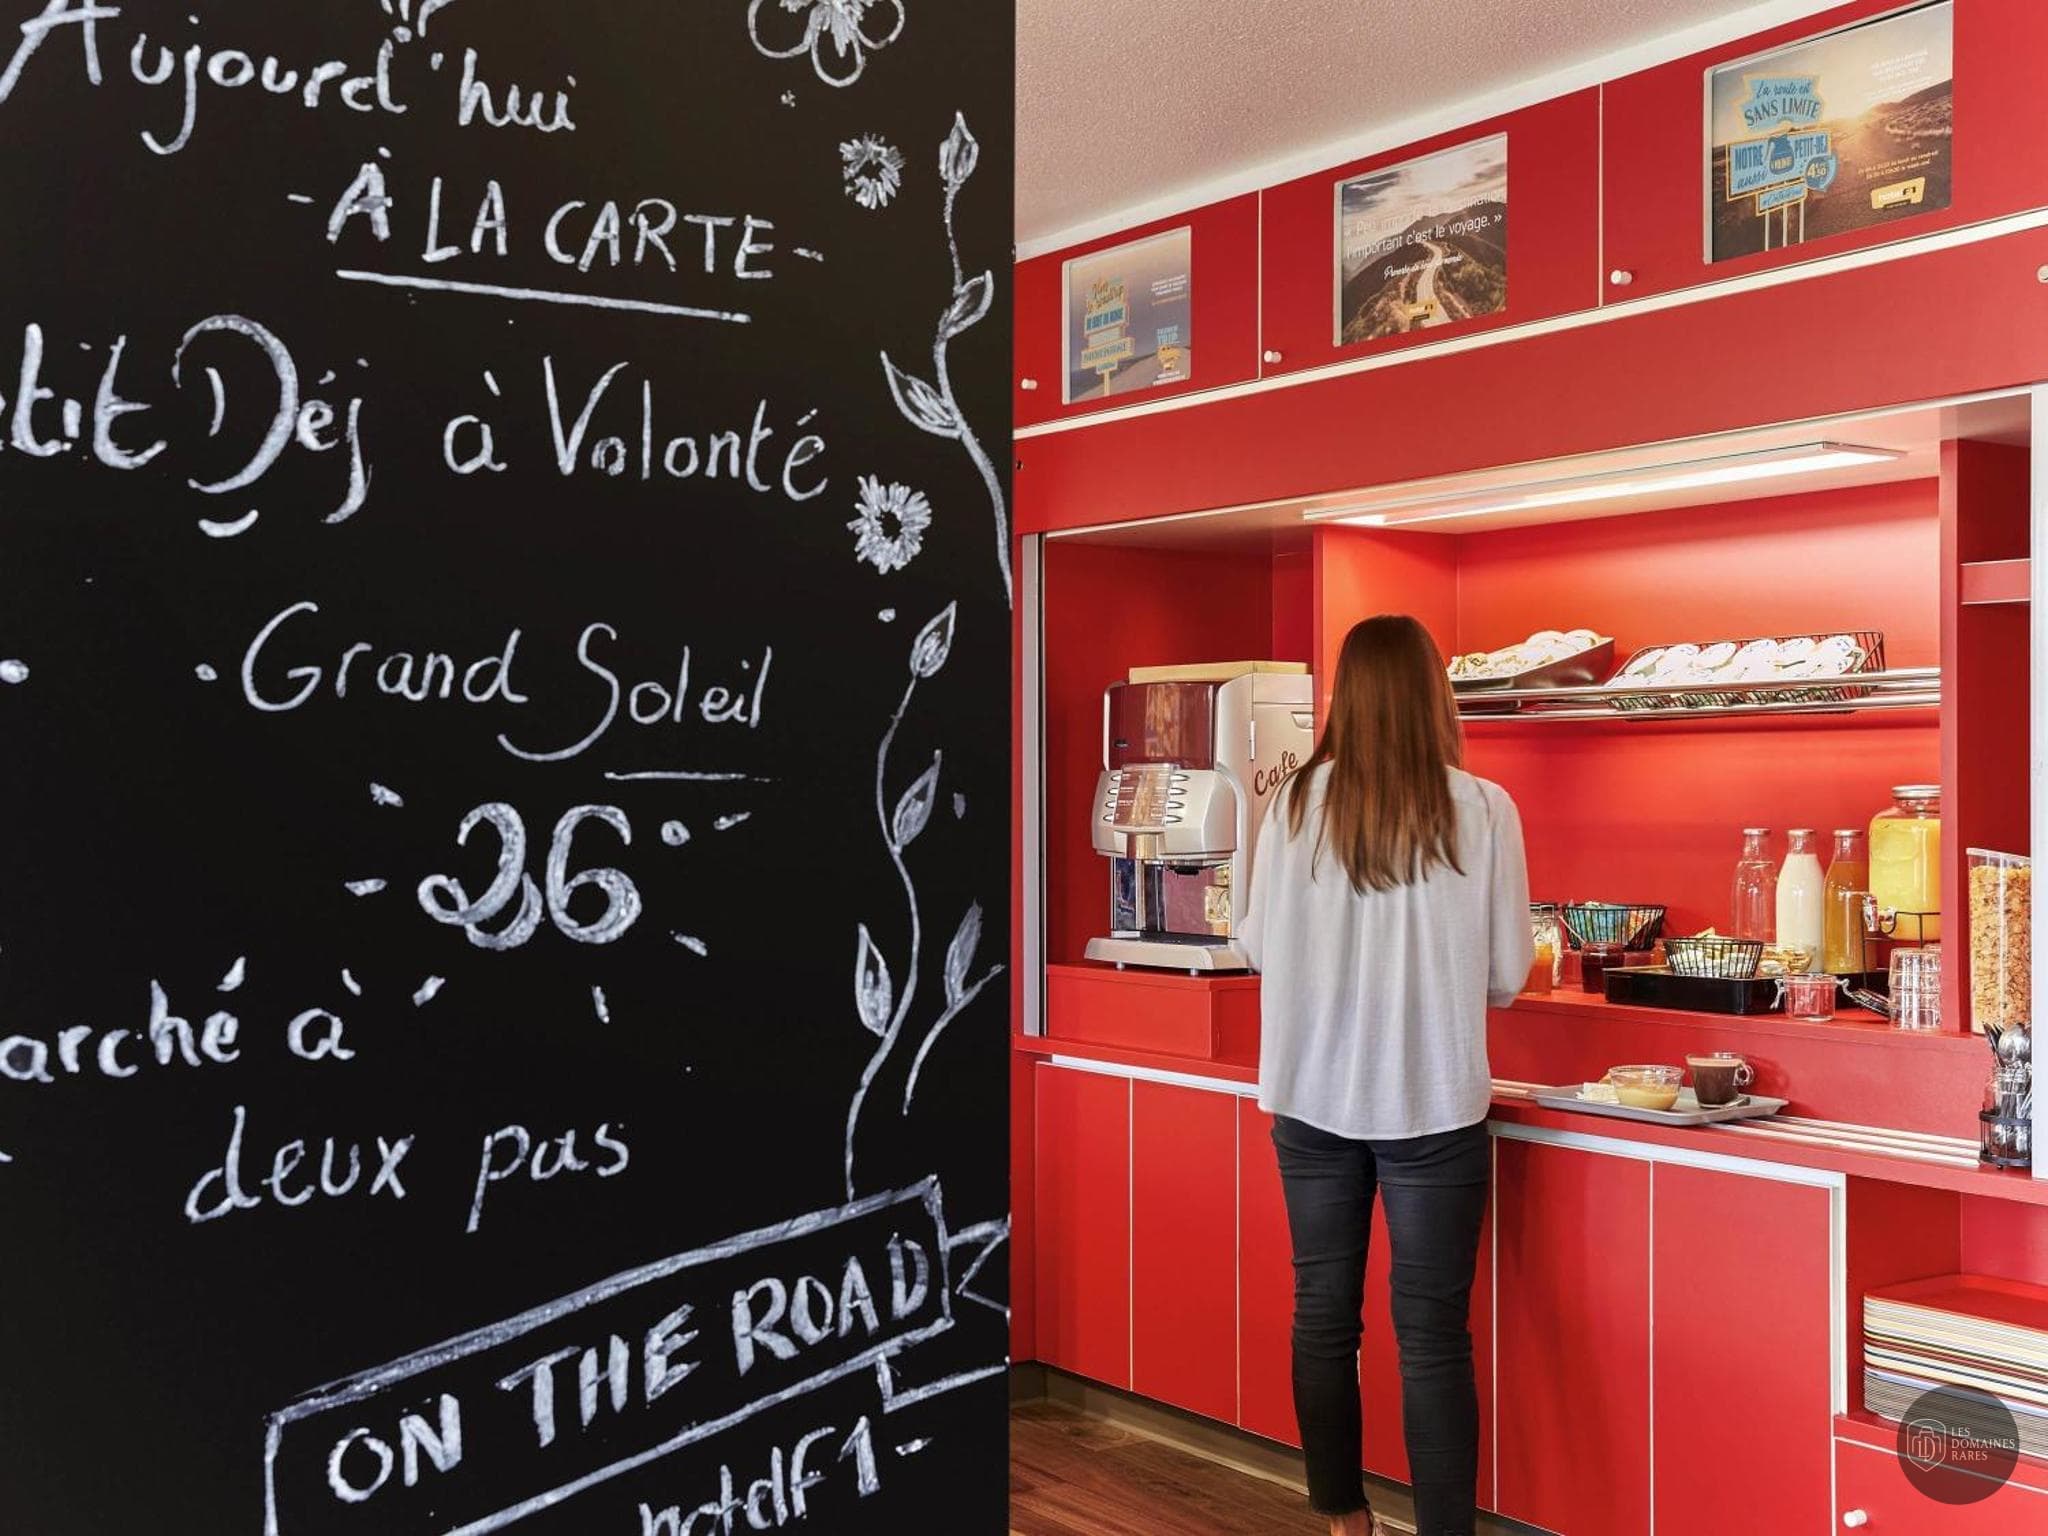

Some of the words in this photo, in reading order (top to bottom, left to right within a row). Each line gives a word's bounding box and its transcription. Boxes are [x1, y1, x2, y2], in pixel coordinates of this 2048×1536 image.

[0, 0, 577, 155] Aujourd'hui
[1744, 99, 1779, 127] SANS
[1782, 97, 1820, 118] LIMITE
[1734, 144, 1764, 171] NOTRE
[422, 177, 508, 262] LA
[545, 199, 774, 279] CARTE
[1435, 223, 1446, 239] le
[1449, 215, 1491, 236] voyage.
[0, 323, 167, 470] tit
[173, 315, 369, 524] Déj
[444, 371, 507, 474] à
[544, 356, 828, 501] Volonté
[242, 602, 528, 710] Grand
[498, 623, 772, 760] Soleil
[289, 968, 361, 1060] à
[186, 1106, 415, 1222] deux
[467, 1124, 629, 1233] pas
[328, 1393, 462, 1503] ON
[498, 1304, 700, 1447] THE
[732, 1234, 929, 1375] ROAD
